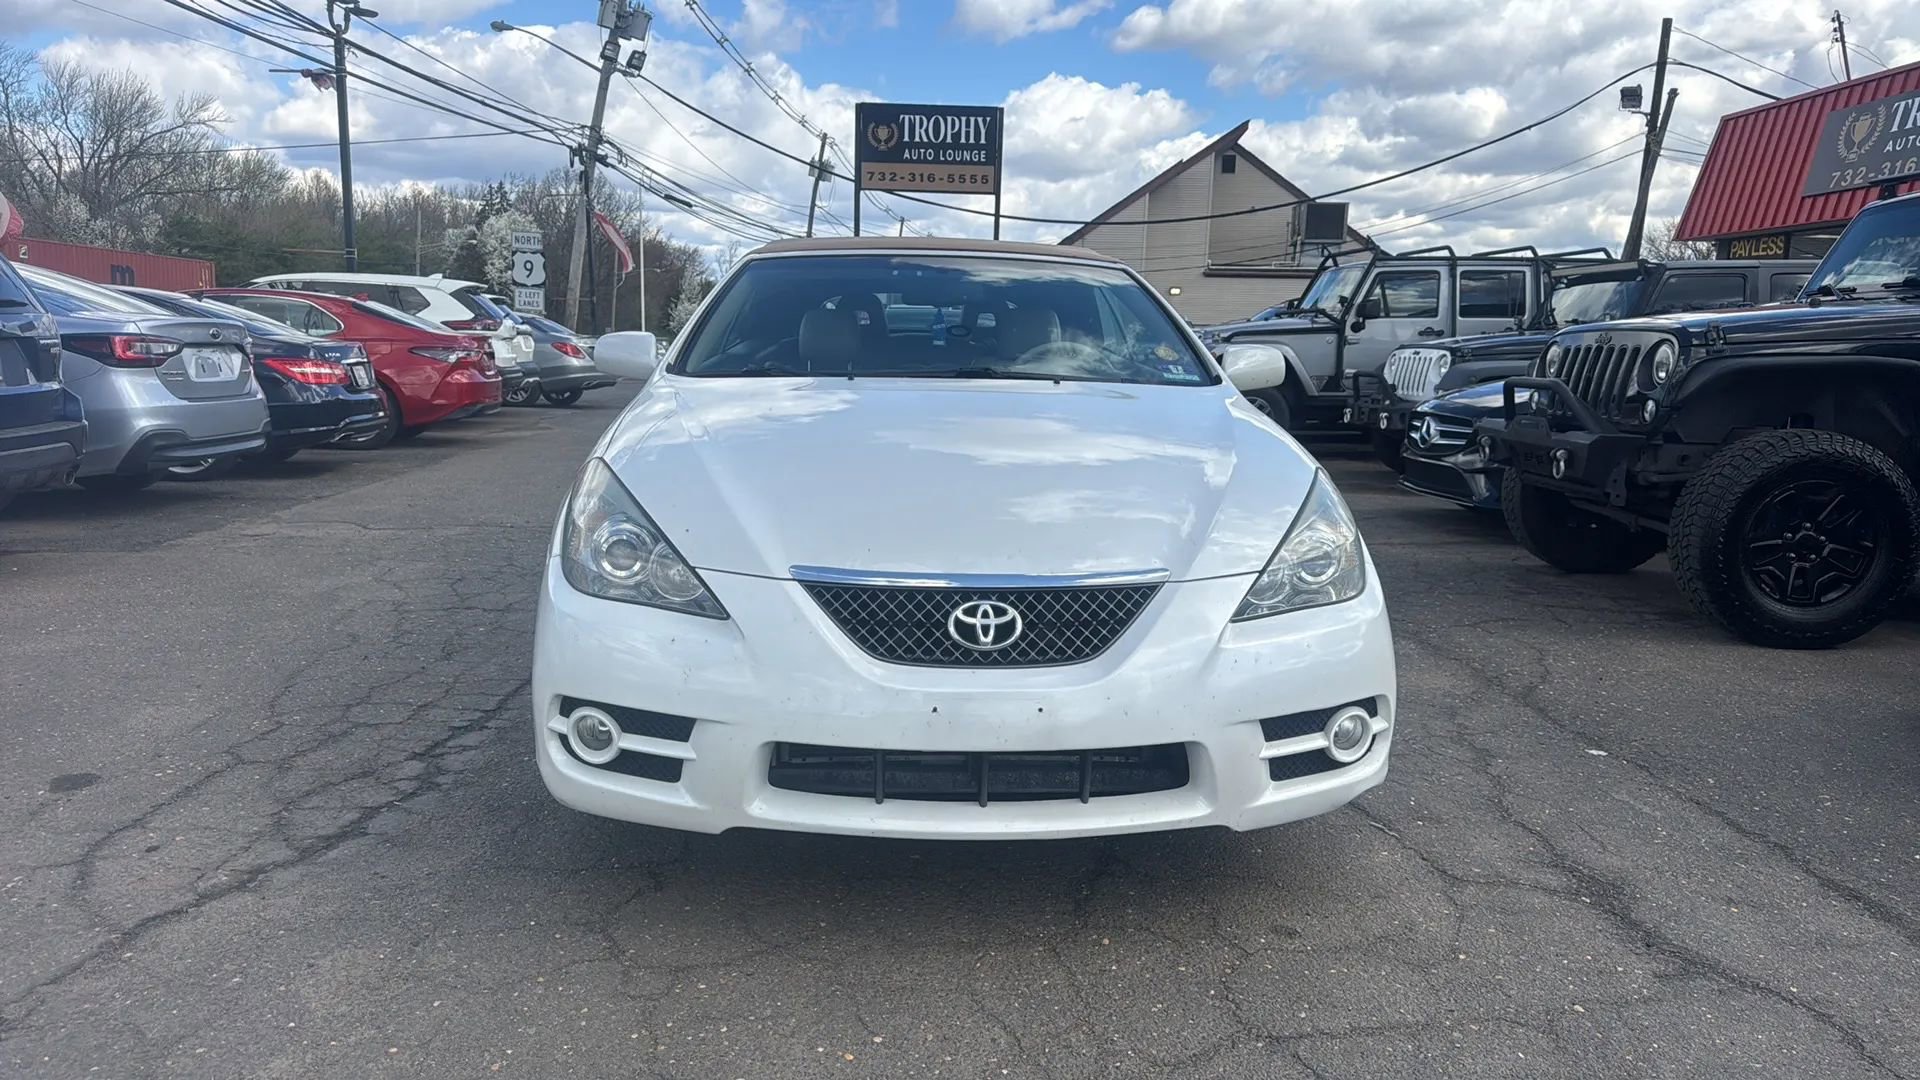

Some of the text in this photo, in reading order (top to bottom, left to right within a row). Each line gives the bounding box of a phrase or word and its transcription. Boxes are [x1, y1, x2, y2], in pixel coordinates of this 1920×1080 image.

[899, 114, 991, 144] TROPHY
[903, 148, 986, 161] AUTO LOUNGE
[866, 171, 989, 185] 732-316-5555
[514, 235, 542, 245] NORTH
[1729, 235, 1785, 259] PAYLESS
[523, 260, 534, 279] 9
[517, 291, 540, 300] 2 LEFT
[518, 300, 541, 308] LANES
